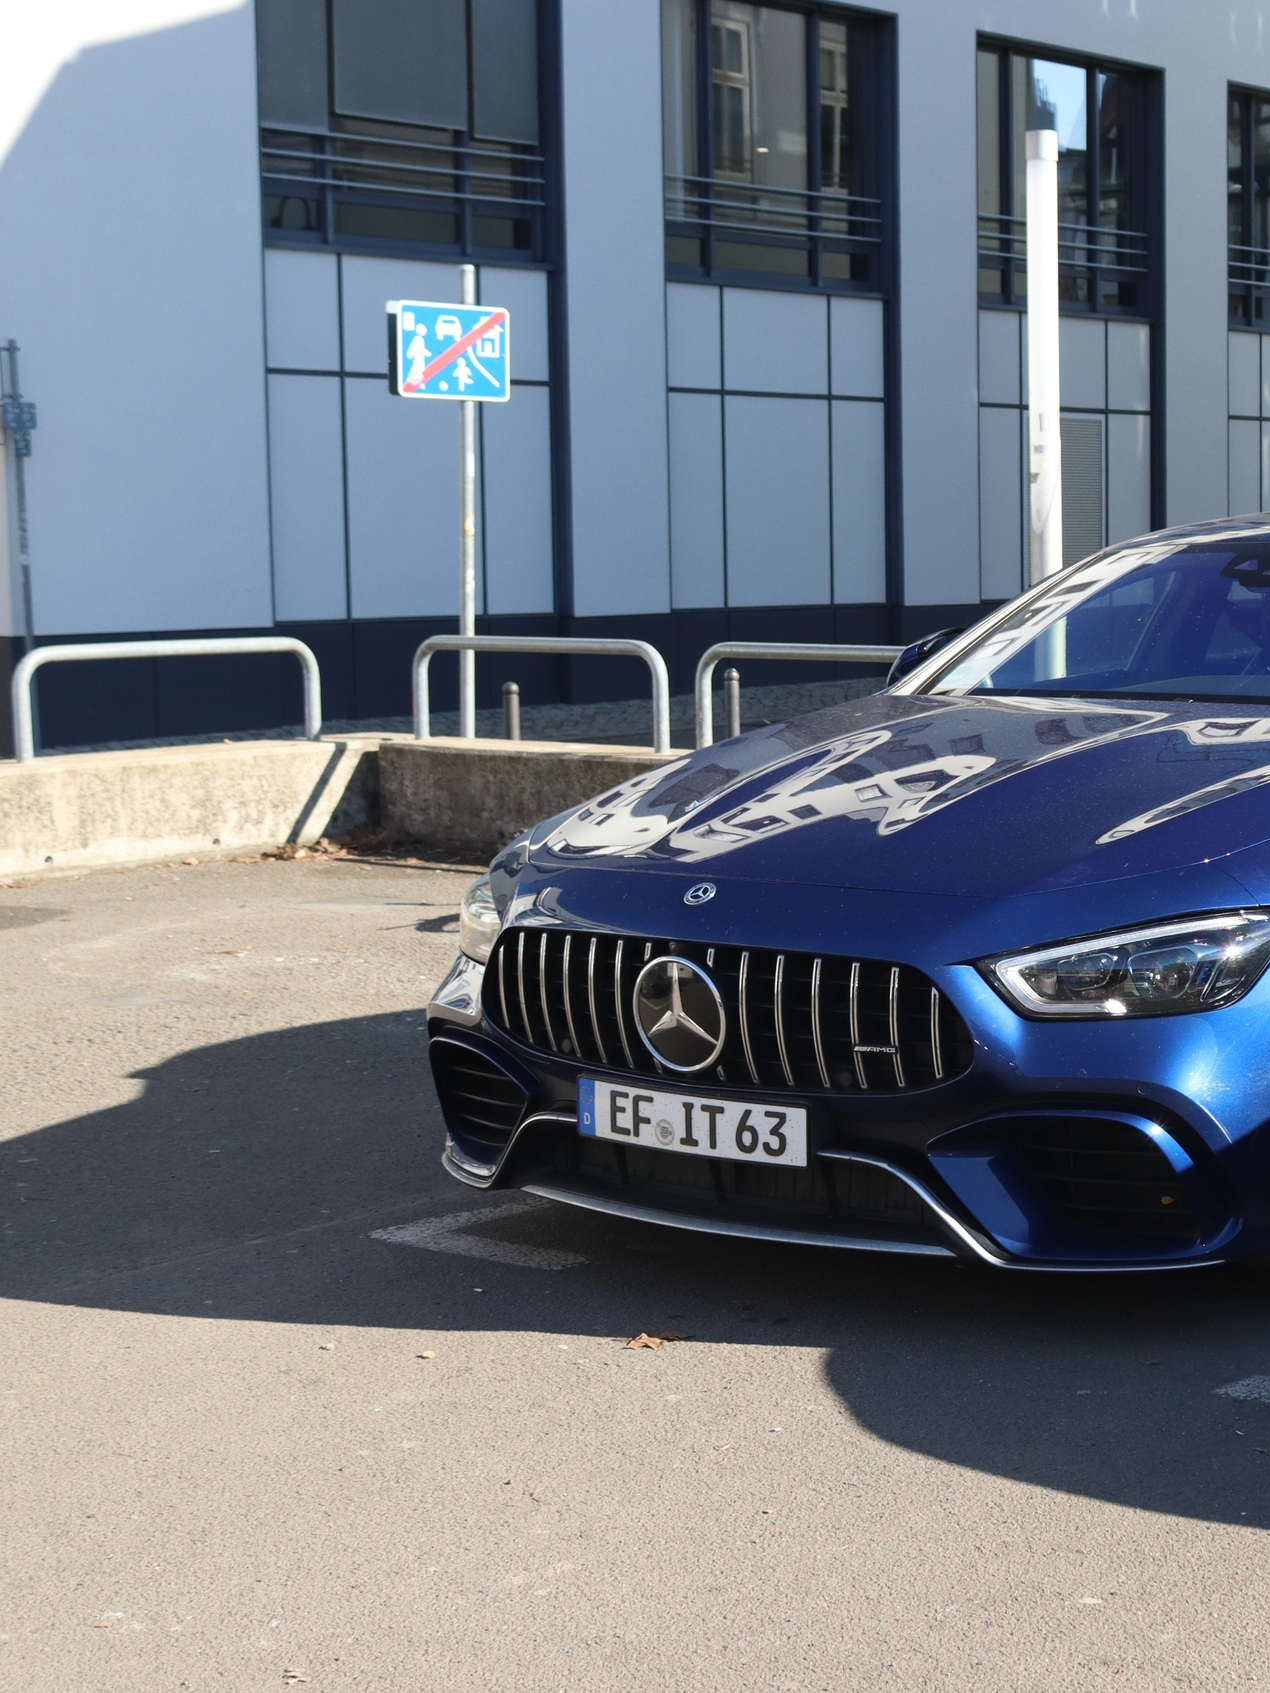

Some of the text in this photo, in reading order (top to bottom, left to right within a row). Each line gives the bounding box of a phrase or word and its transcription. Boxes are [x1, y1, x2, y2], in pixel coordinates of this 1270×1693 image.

[583, 1112, 591, 1125] D
[610, 1089, 654, 1137] EF
[680, 1101, 725, 1150] IT
[735, 1109, 787, 1157] 63
